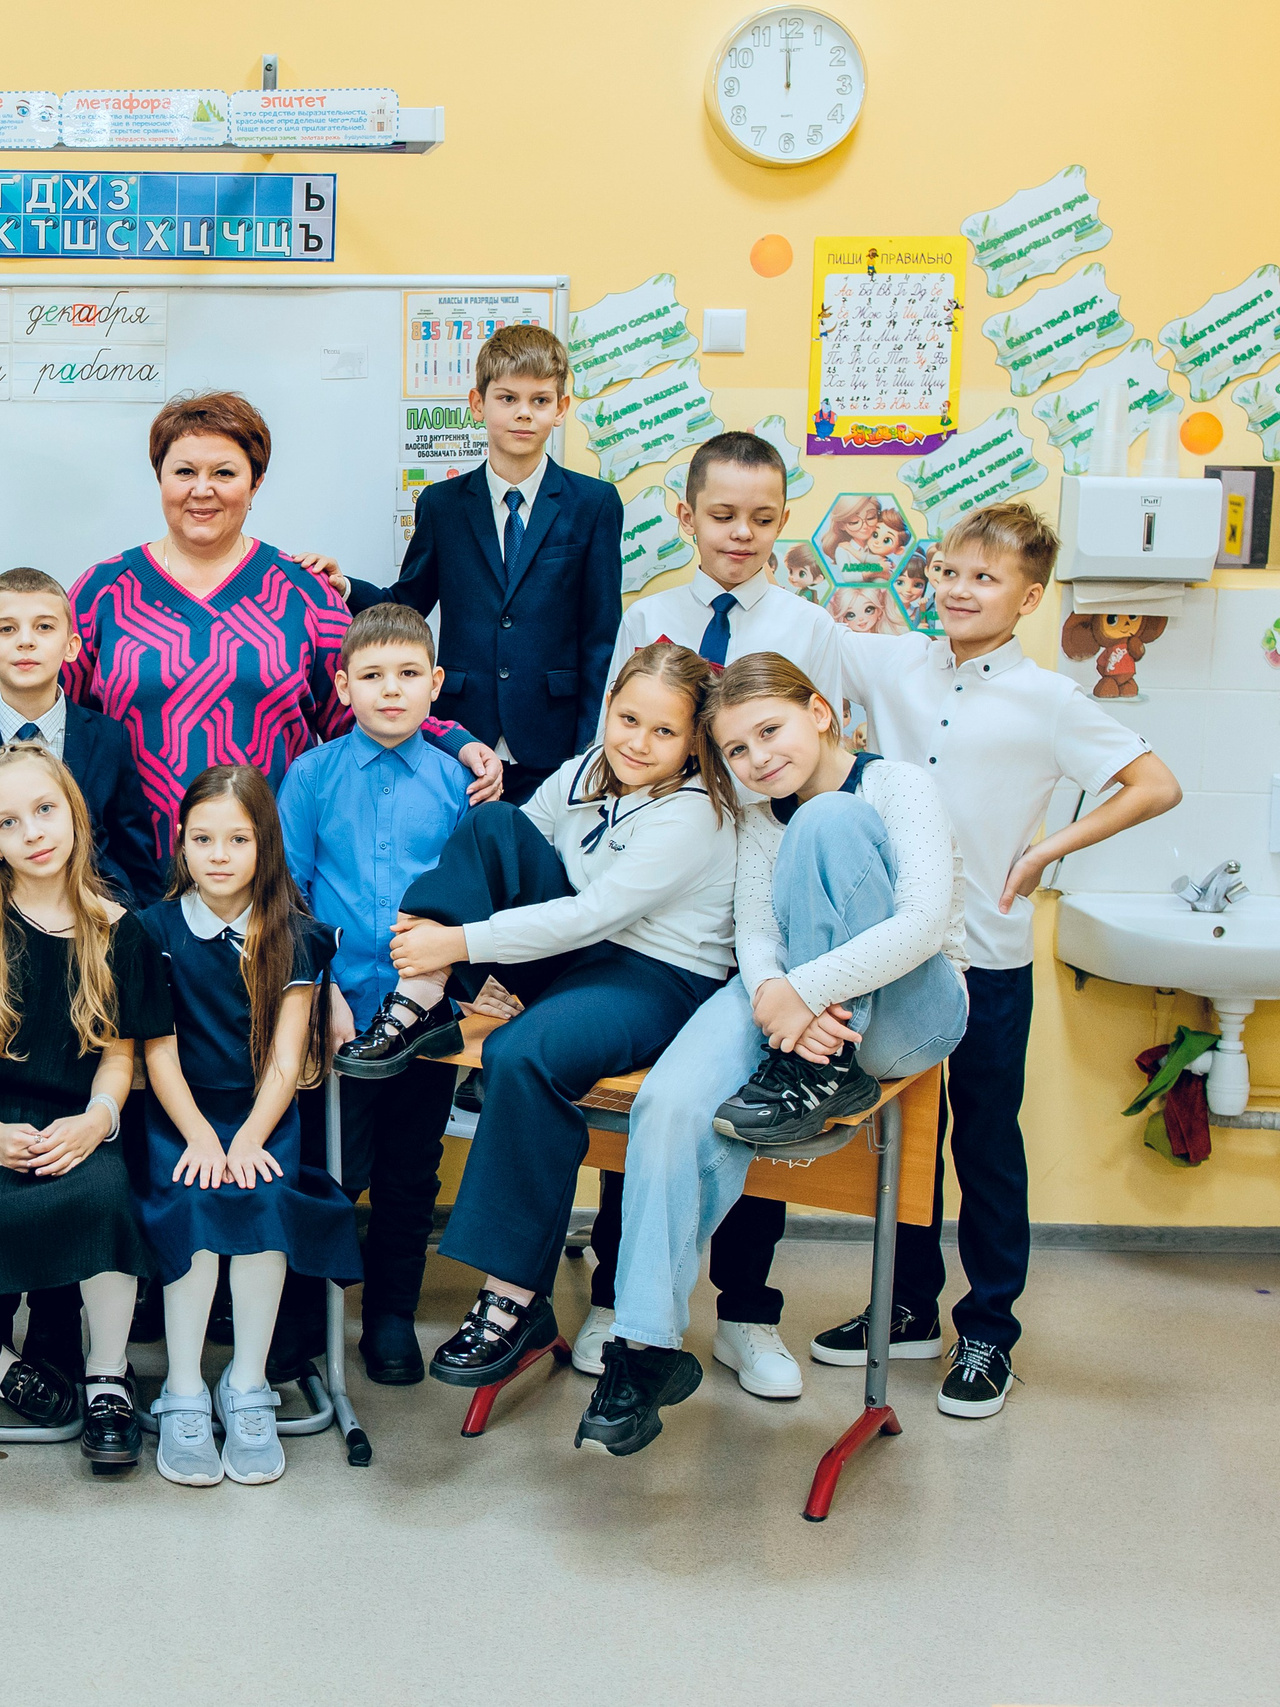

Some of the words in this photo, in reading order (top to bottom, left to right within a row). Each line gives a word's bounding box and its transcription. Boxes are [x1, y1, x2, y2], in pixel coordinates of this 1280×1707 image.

[752, 26, 771, 47] 11
[779, 18, 803, 38] 12
[814, 25, 822, 46] 1
[729, 48, 753, 68] 10
[830, 46, 846, 66] 2
[724, 77, 740, 97] 9
[836, 75, 852, 95] 3
[76, 93, 171, 113] метафора
[260, 96, 327, 108] эпитет
[731, 105, 746, 125] 8
[828, 104, 844, 123] 4
[751, 126, 767, 146] 7
[778, 133, 794, 153] 6
[807, 125, 823, 145] 5
[26, 179, 56, 213] Д
[63, 180, 98, 210] Ж
[108, 180, 130, 210] З
[305, 182, 325, 212] Ь
[32, 220, 57, 250] Т
[64, 221, 96, 251] Ш
[106, 221, 130, 251] С
[144, 222, 171, 251] Х
[184, 222, 210, 255] Ц
[223, 222, 246, 252] Ч
[256, 222, 292, 257] Щ
[299, 223, 323, 252] Ъ
[828, 254, 862, 264] ПИШИ
[881, 253, 952, 264] ПРАВИЛЬНО
[25, 290, 150, 337] декабря
[33, 348, 158, 394] работа
[429, 434, 469, 442] ВНУТРЕННЯЯ
[459, 448, 482, 456] БУКВОЙ
